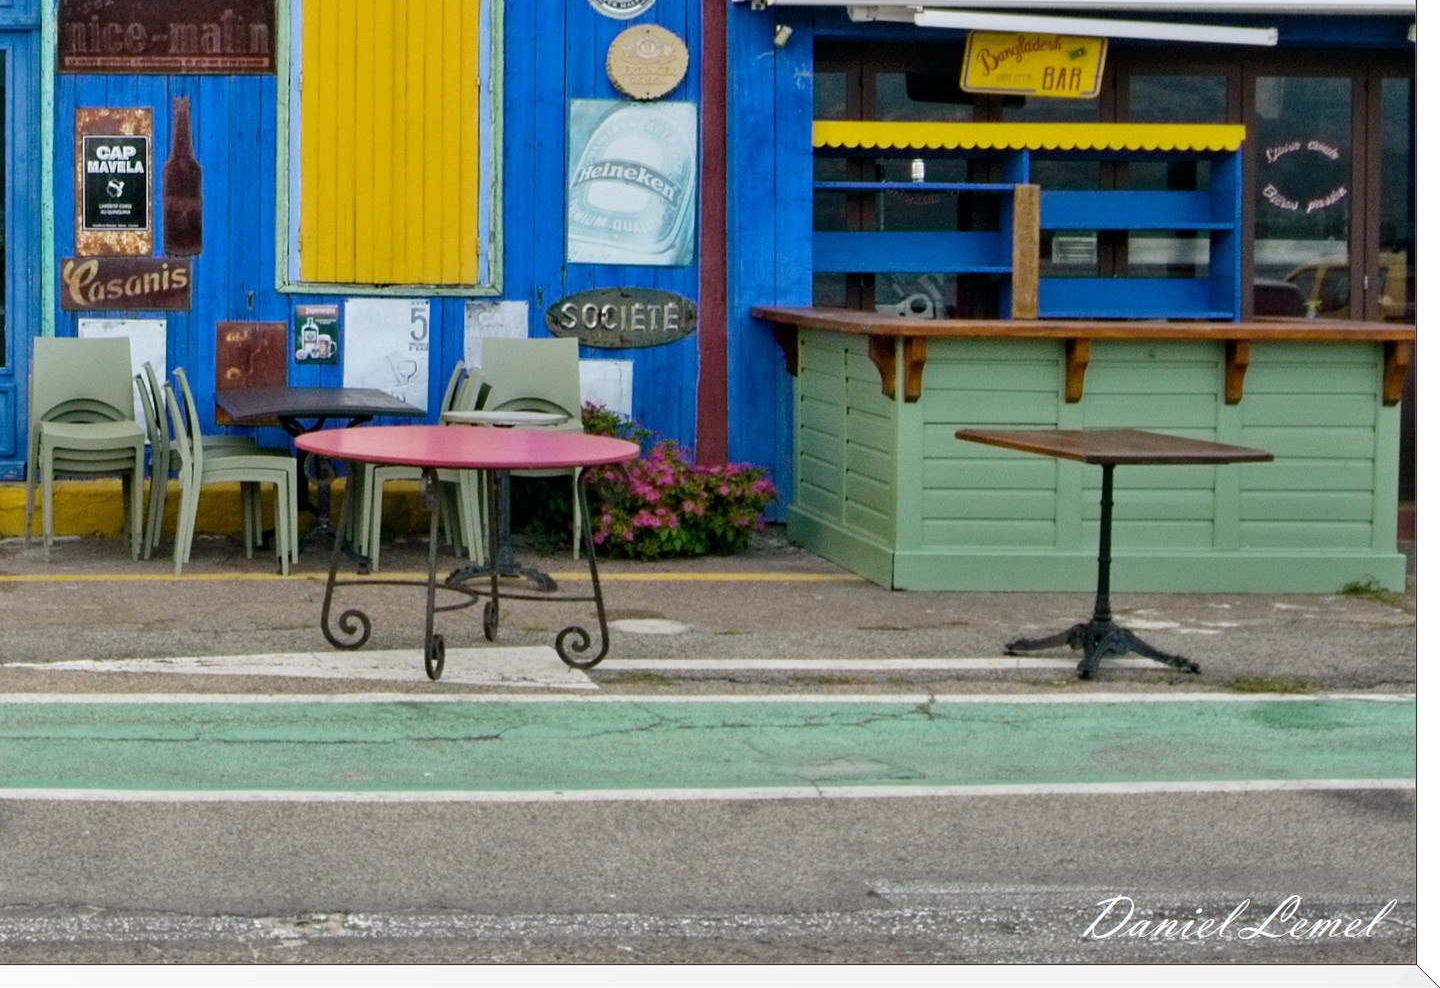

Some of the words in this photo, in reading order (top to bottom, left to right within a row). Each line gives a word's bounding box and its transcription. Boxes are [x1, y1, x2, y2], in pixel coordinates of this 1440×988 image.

[976, 34, 1062, 77] Bangladesh
[1041, 66, 1083, 92] BAR
[87, 160, 145, 174] MAVELA
[95, 145, 137, 161] CAP
[577, 162, 676, 202] Heineken
[63, 259, 188, 306] Casanis
[410, 308, 427, 342] 5
[560, 301, 679, 332] SOCIÉTÉ
